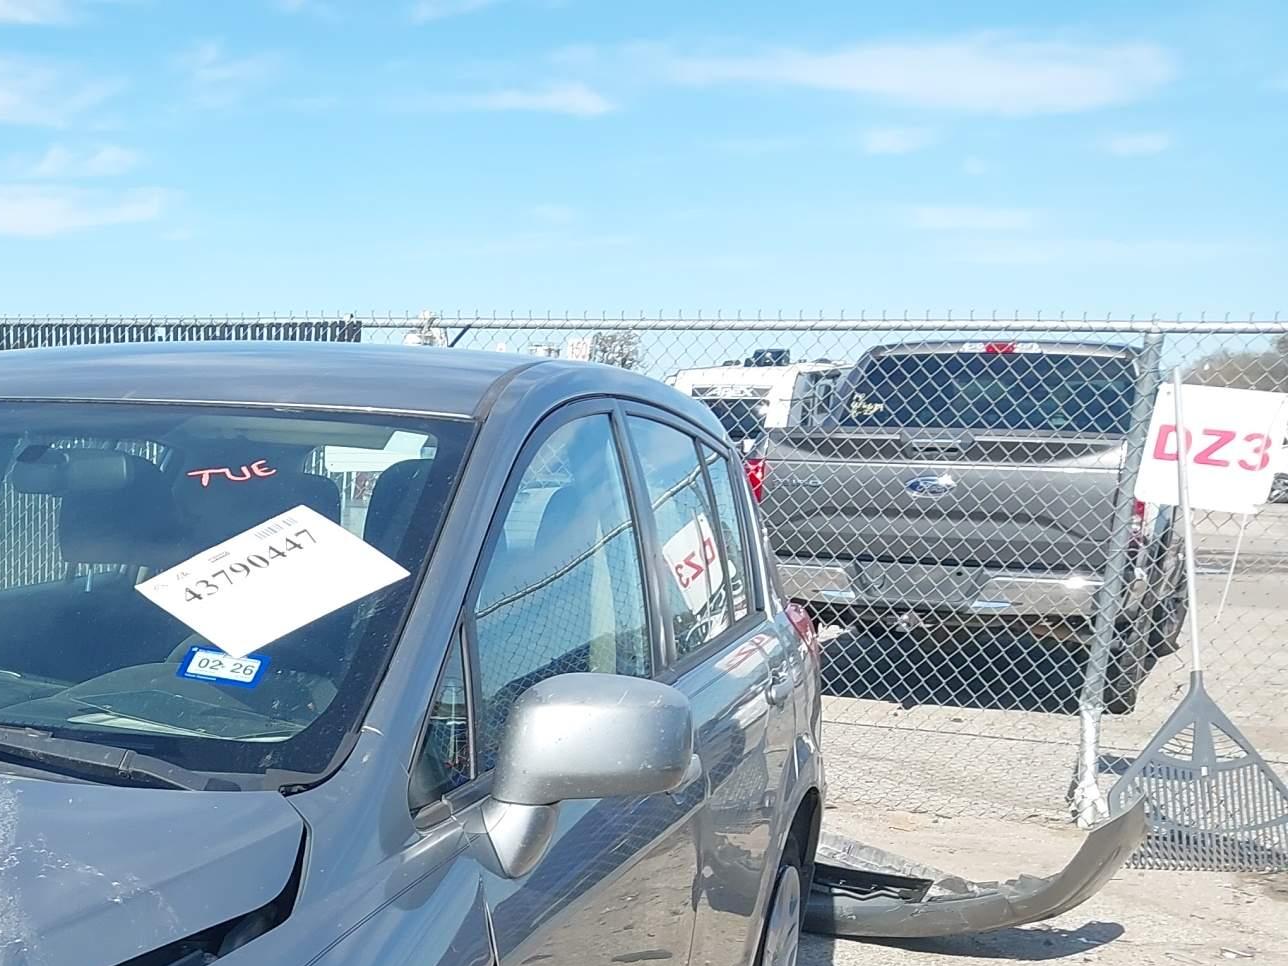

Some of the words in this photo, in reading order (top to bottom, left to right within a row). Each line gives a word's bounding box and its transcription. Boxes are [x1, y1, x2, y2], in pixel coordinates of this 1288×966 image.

[1152, 424, 1273, 472] DZ3
[186, 459, 277, 487] TUE
[183, 528, 317, 602] 43790447
